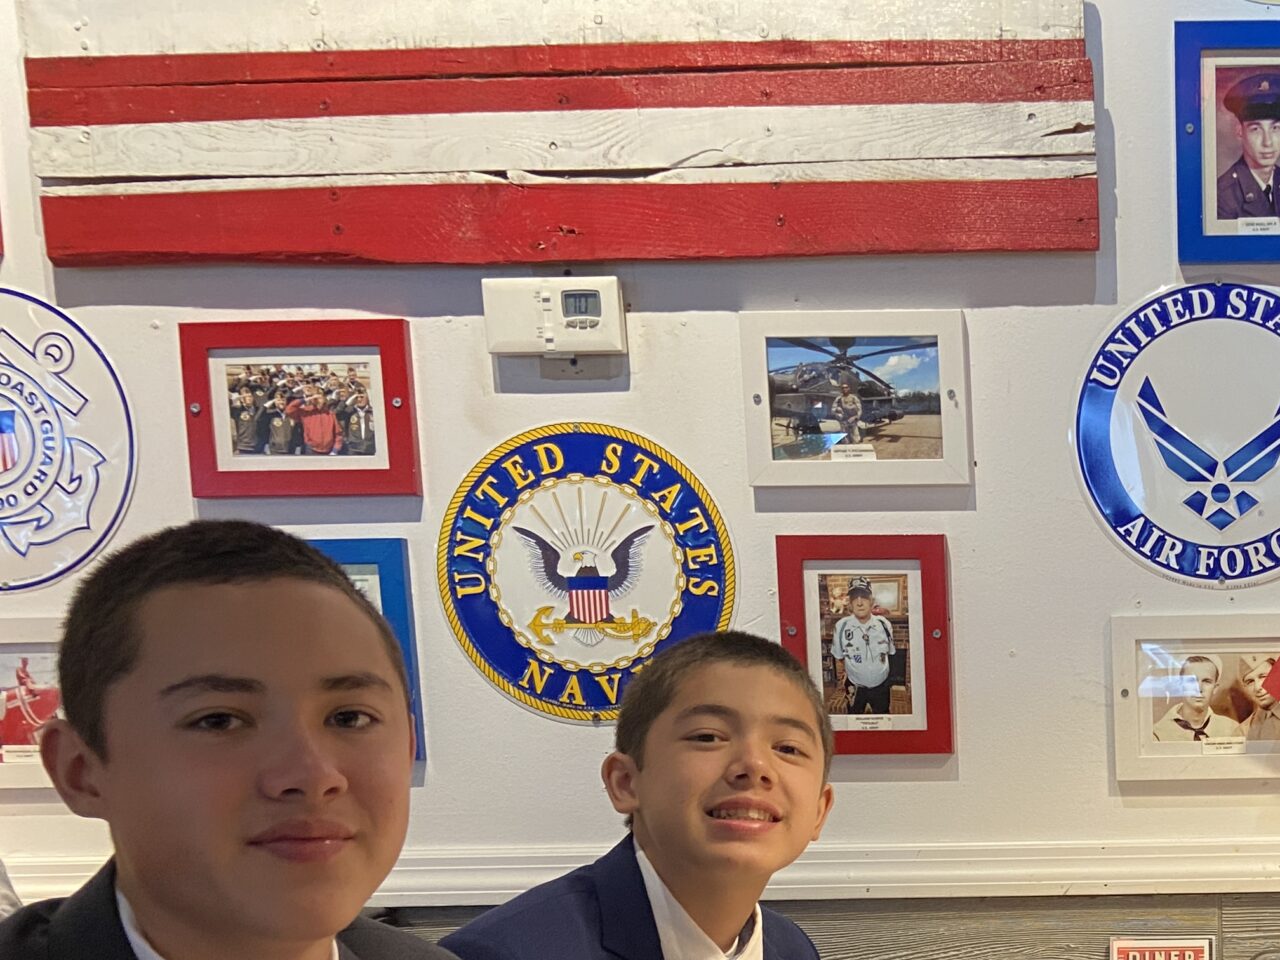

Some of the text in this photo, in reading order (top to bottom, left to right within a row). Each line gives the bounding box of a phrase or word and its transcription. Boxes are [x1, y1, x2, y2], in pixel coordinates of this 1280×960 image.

[1090, 288, 1215, 388] UNITED
[0, 373, 55, 497] OAST GUARD
[454, 443, 719, 599] UNITED STATES
[1117, 515, 1184, 570] AIR
[518, 657, 652, 706] NAV
